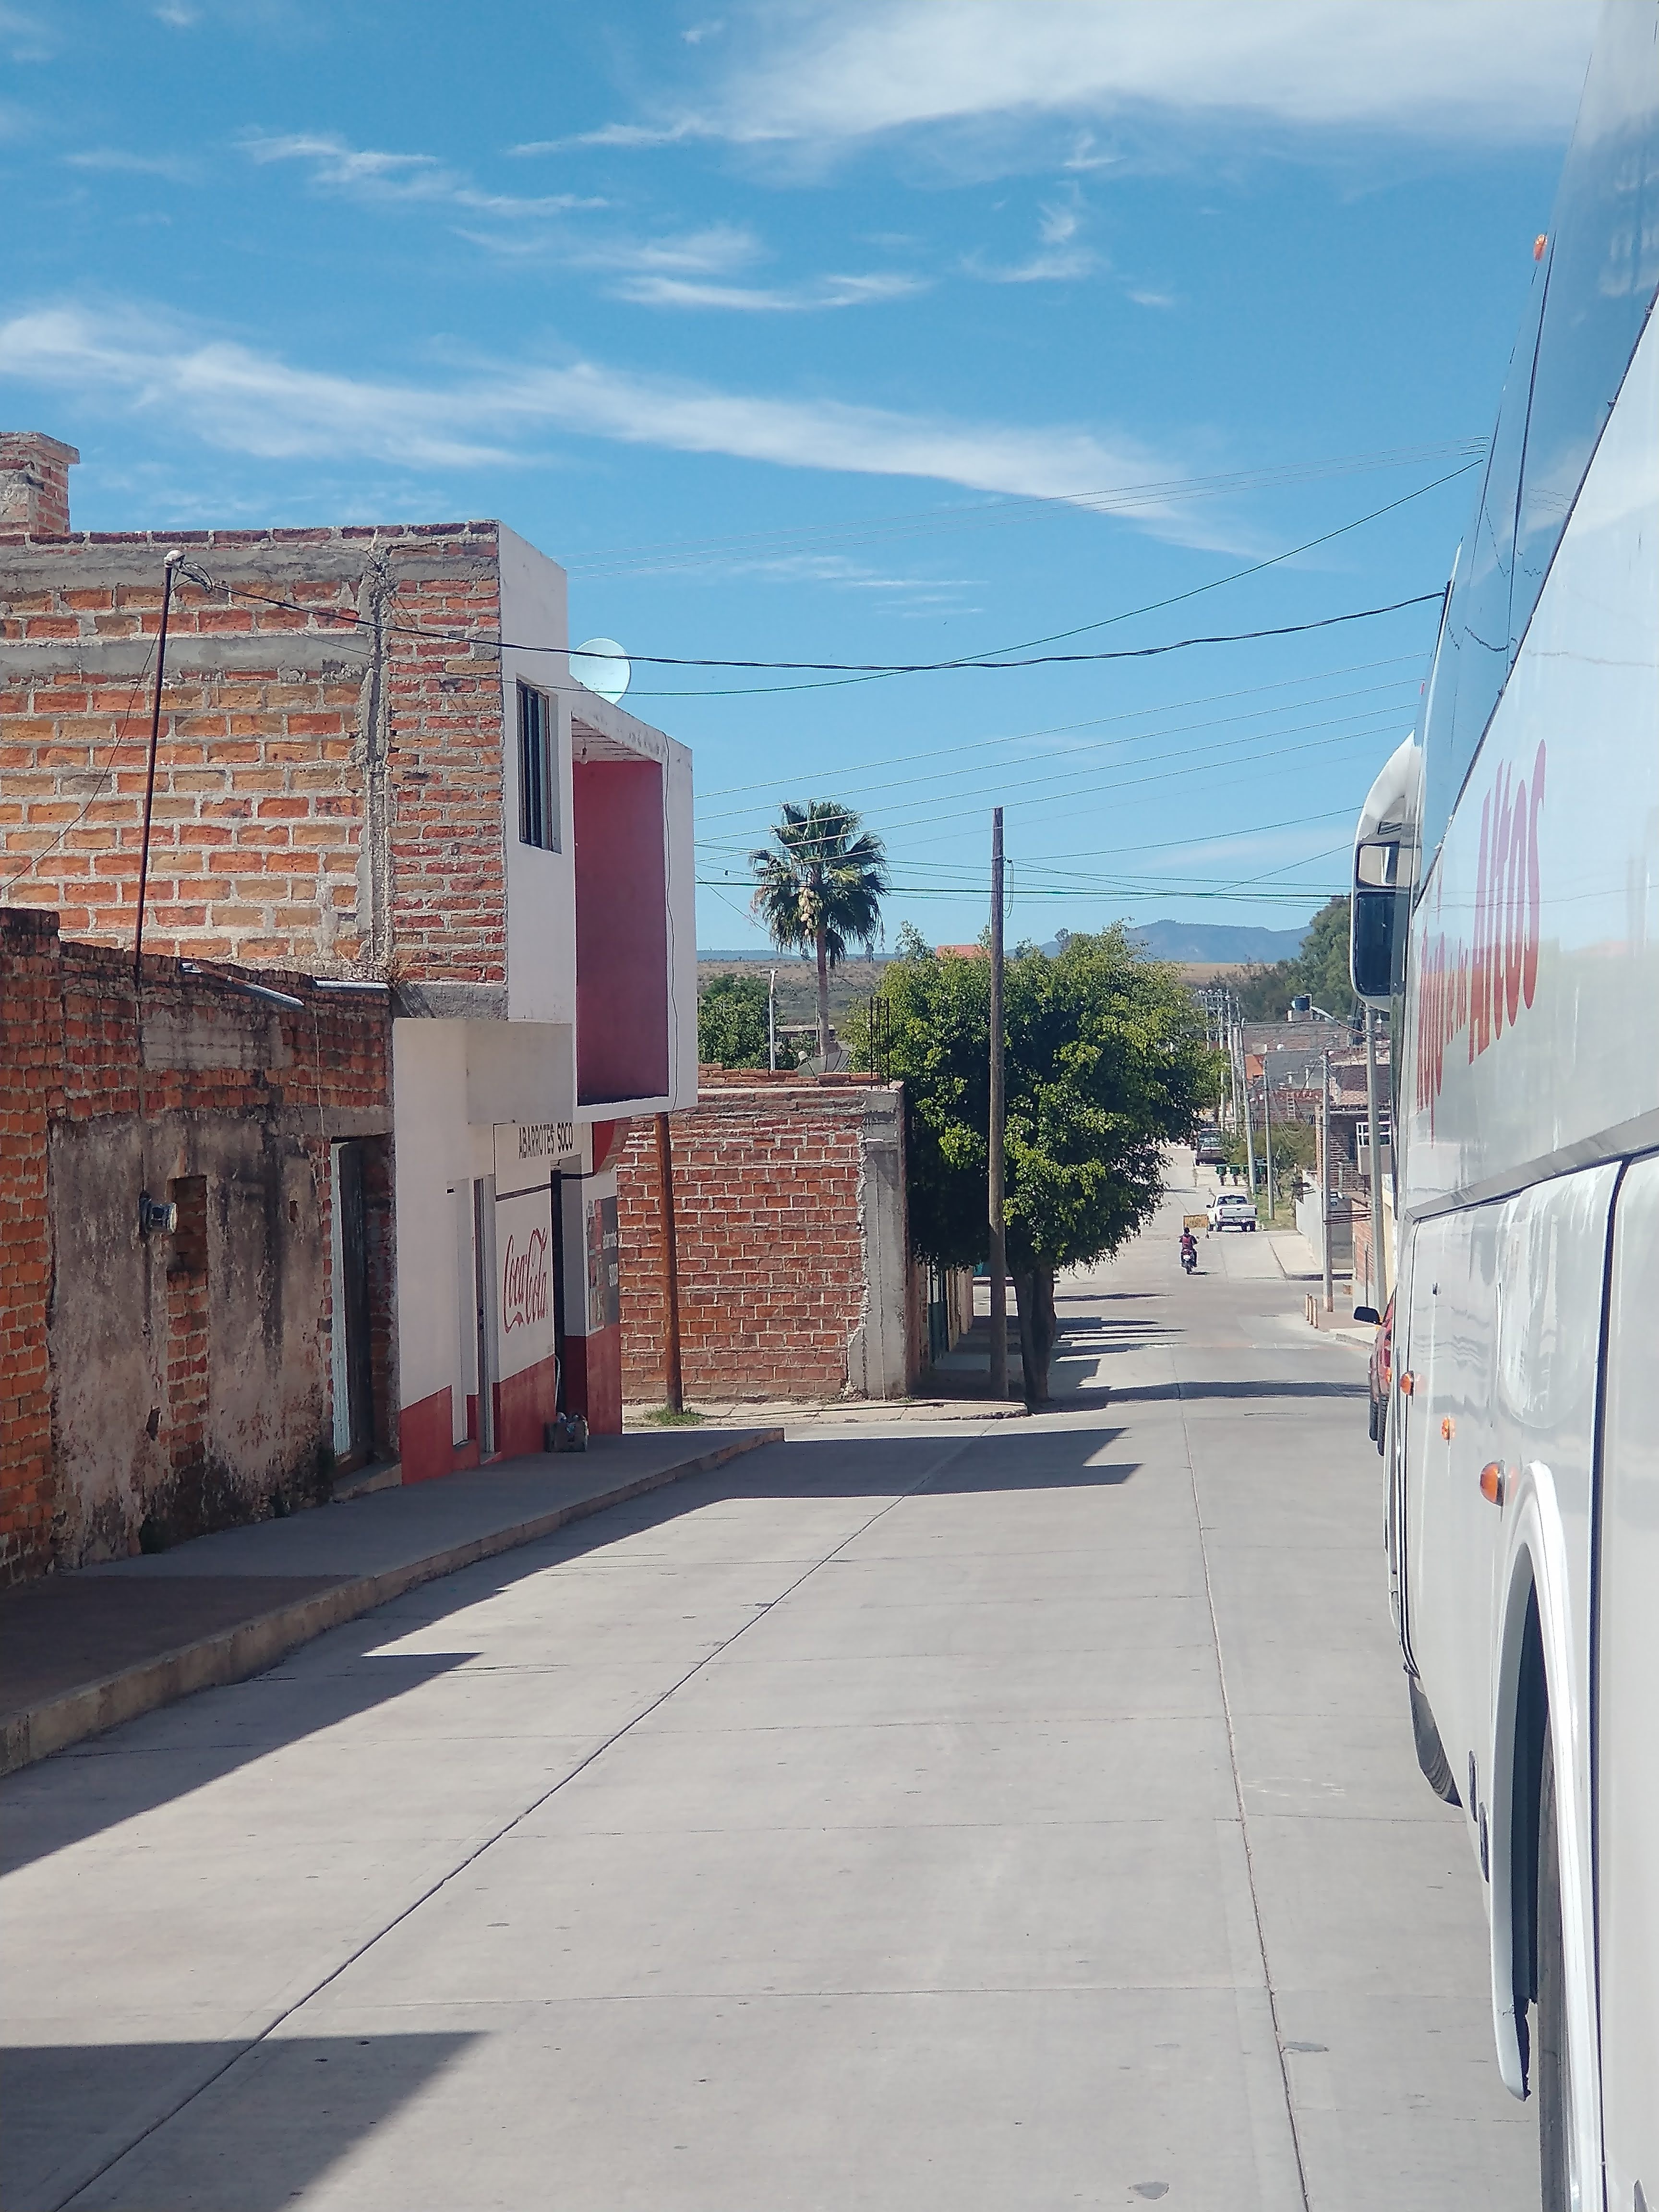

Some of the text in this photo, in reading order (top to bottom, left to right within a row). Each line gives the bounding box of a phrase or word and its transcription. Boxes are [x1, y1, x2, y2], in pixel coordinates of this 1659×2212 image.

[1469, 739, 1546, 1065] Altos
[518, 1122, 573, 1159] ABARROTES SOCO
